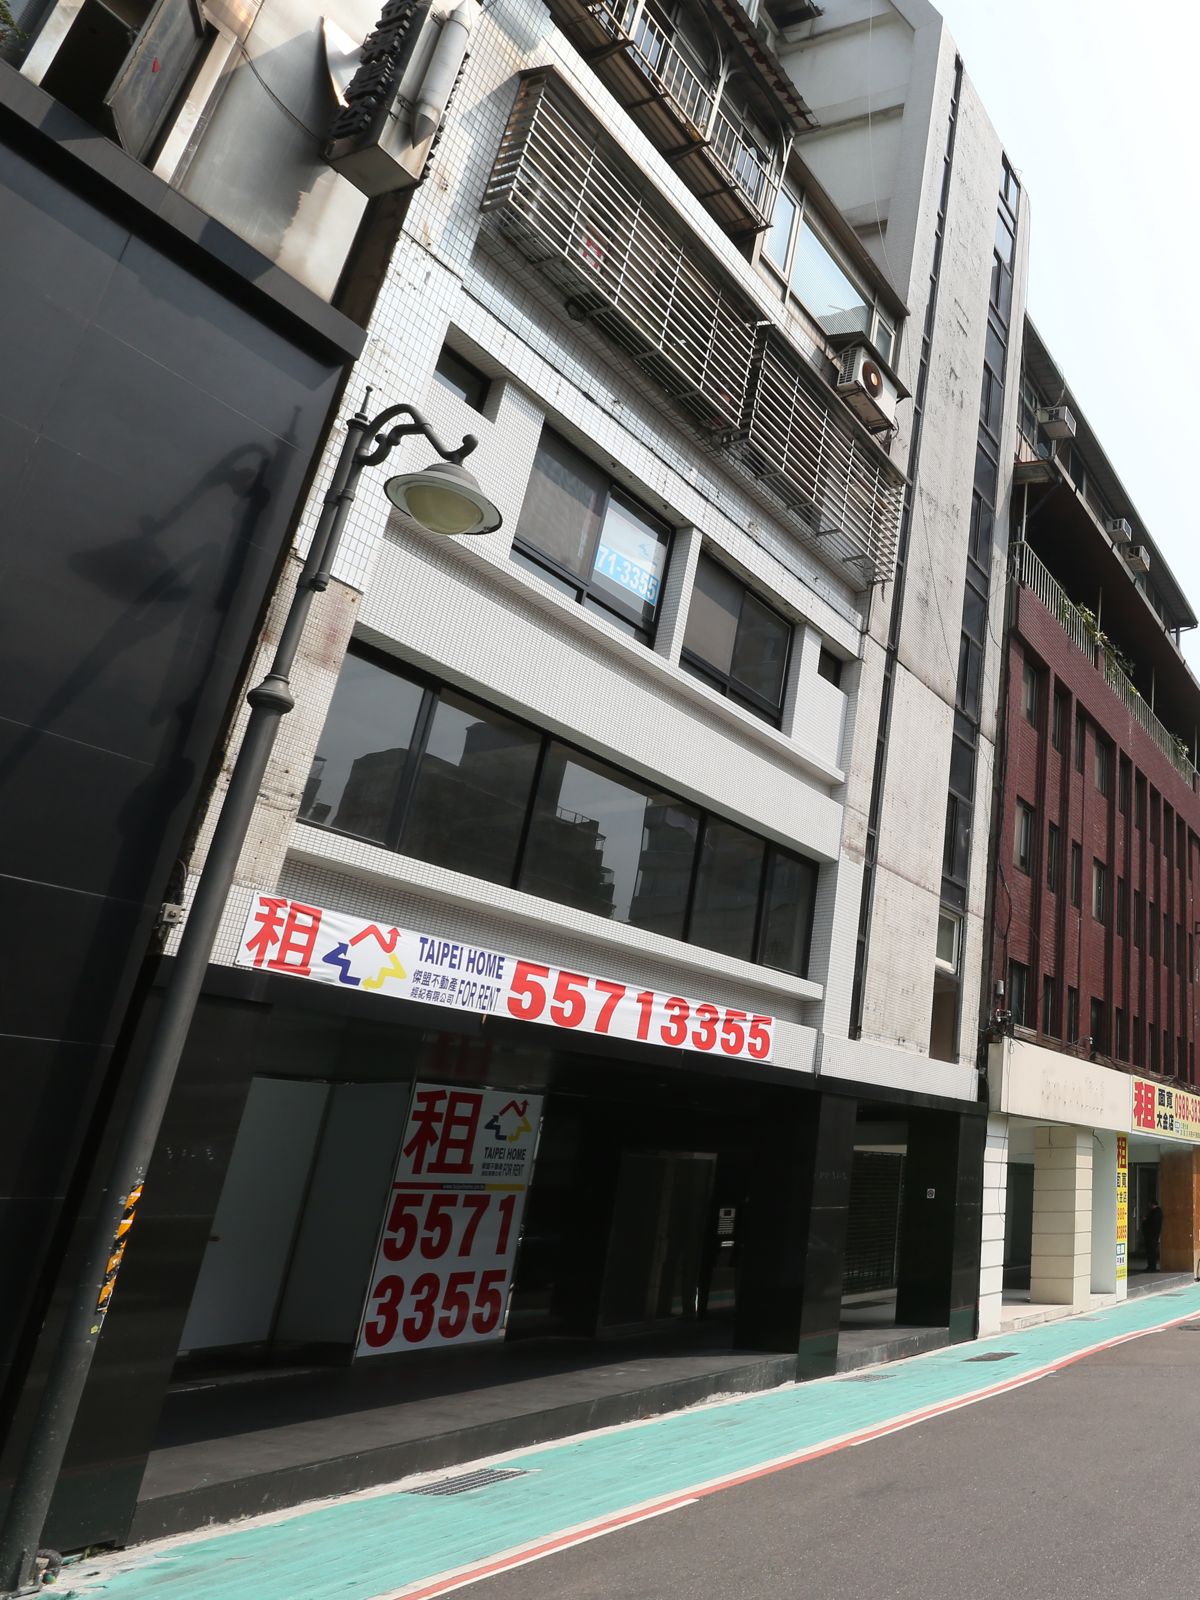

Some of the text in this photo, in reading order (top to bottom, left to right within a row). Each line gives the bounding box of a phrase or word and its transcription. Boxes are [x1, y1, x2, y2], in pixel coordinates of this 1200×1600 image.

[245, 896, 322, 977] 租
[419, 937, 505, 979] TAIPEI HOME
[410, 987, 454, 1005] 經紀有限公司
[412, 969, 458, 992] 傑盟不動產
[455, 979, 501, 1012] FOR RENT
[507, 960, 772, 1059] 55713355
[1134, 1080, 1156, 1130] 租
[403, 1090, 483, 1175] 租
[484, 1147, 527, 1161] TAIPEI HOME
[383, 1194, 516, 1262] 5571
[365, 1269, 507, 1349] 3355
